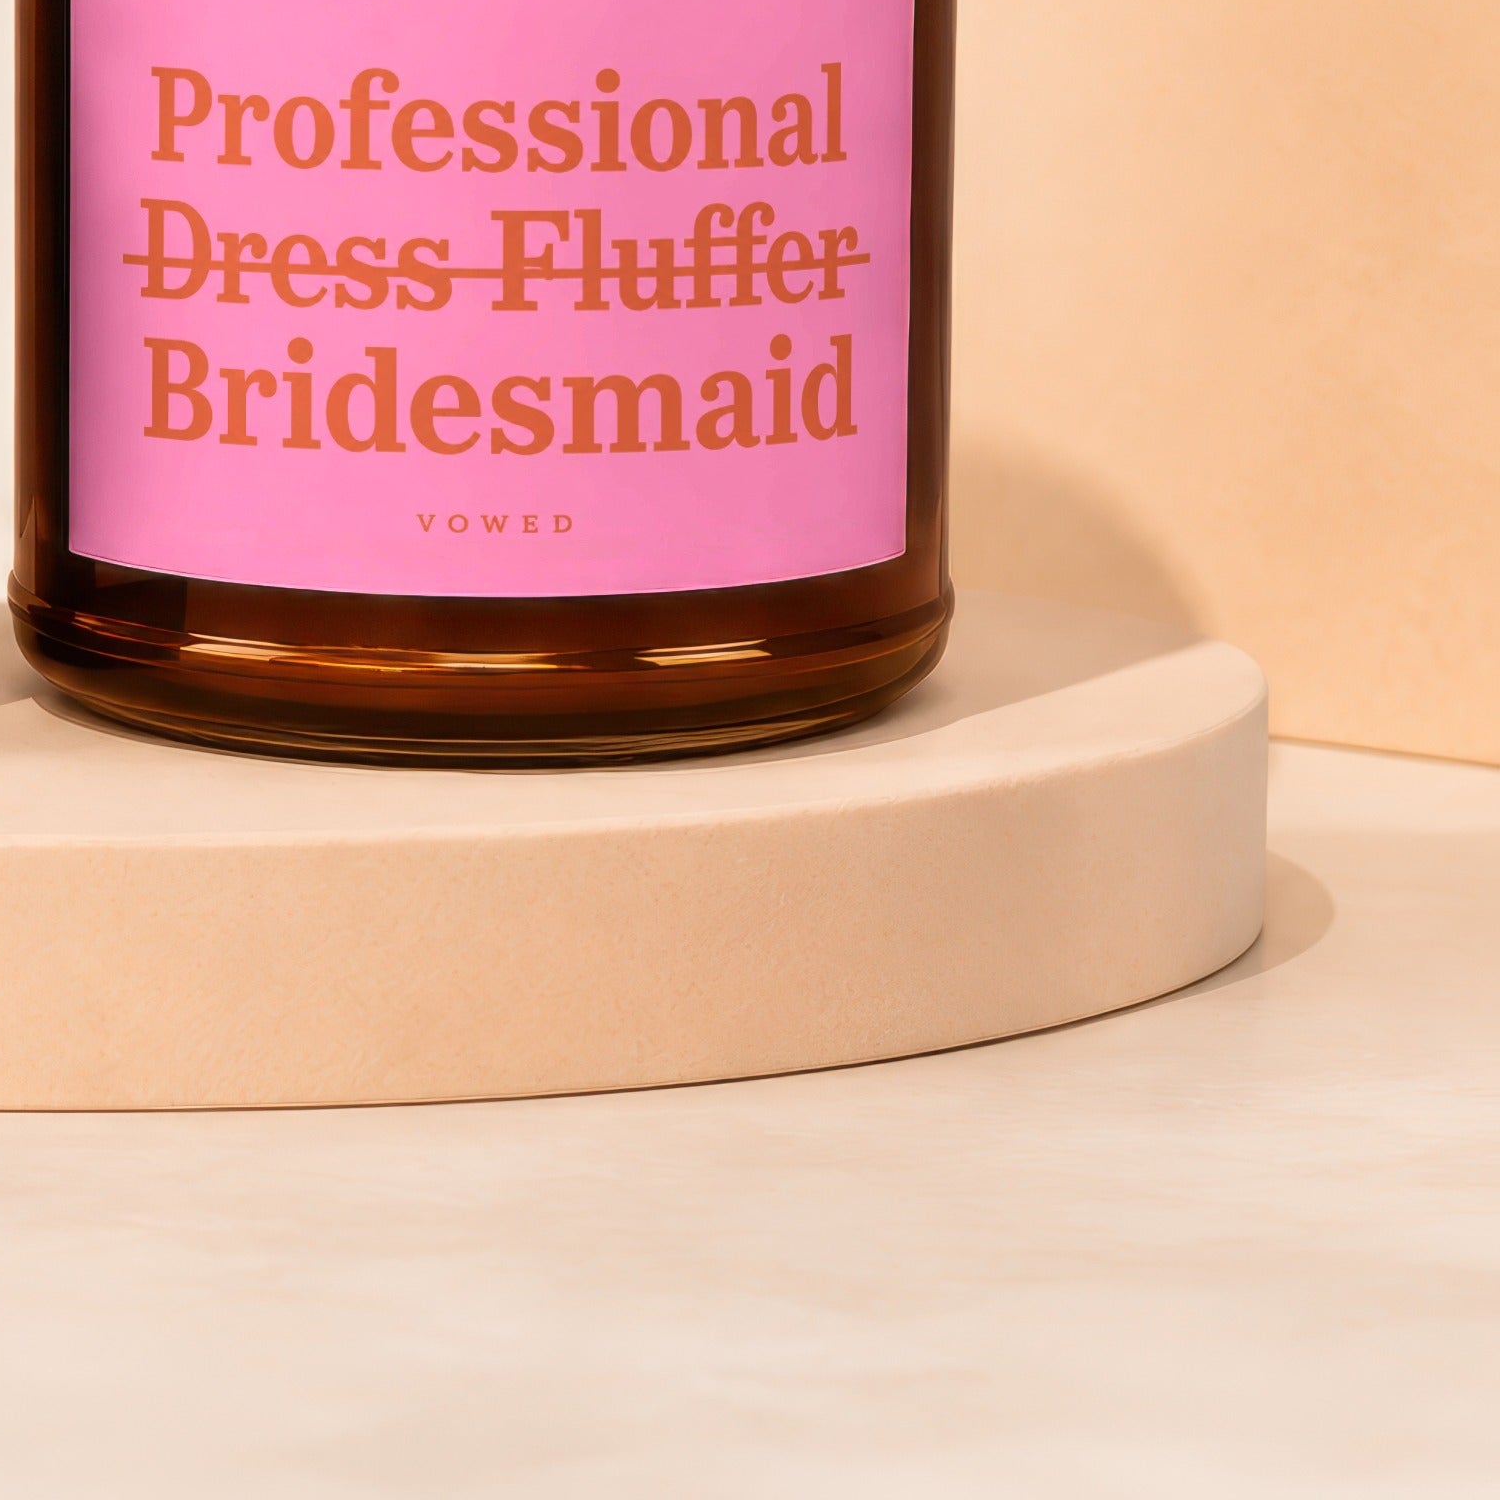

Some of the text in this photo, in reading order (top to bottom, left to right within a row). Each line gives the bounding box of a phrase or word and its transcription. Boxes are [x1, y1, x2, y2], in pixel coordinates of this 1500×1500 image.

[150, 61, 848, 174] Professional
[139, 197, 860, 312] Dress Fluffer
[143, 333, 858, 457] Bridesmaid
[416, 513, 575, 534] VOWED
